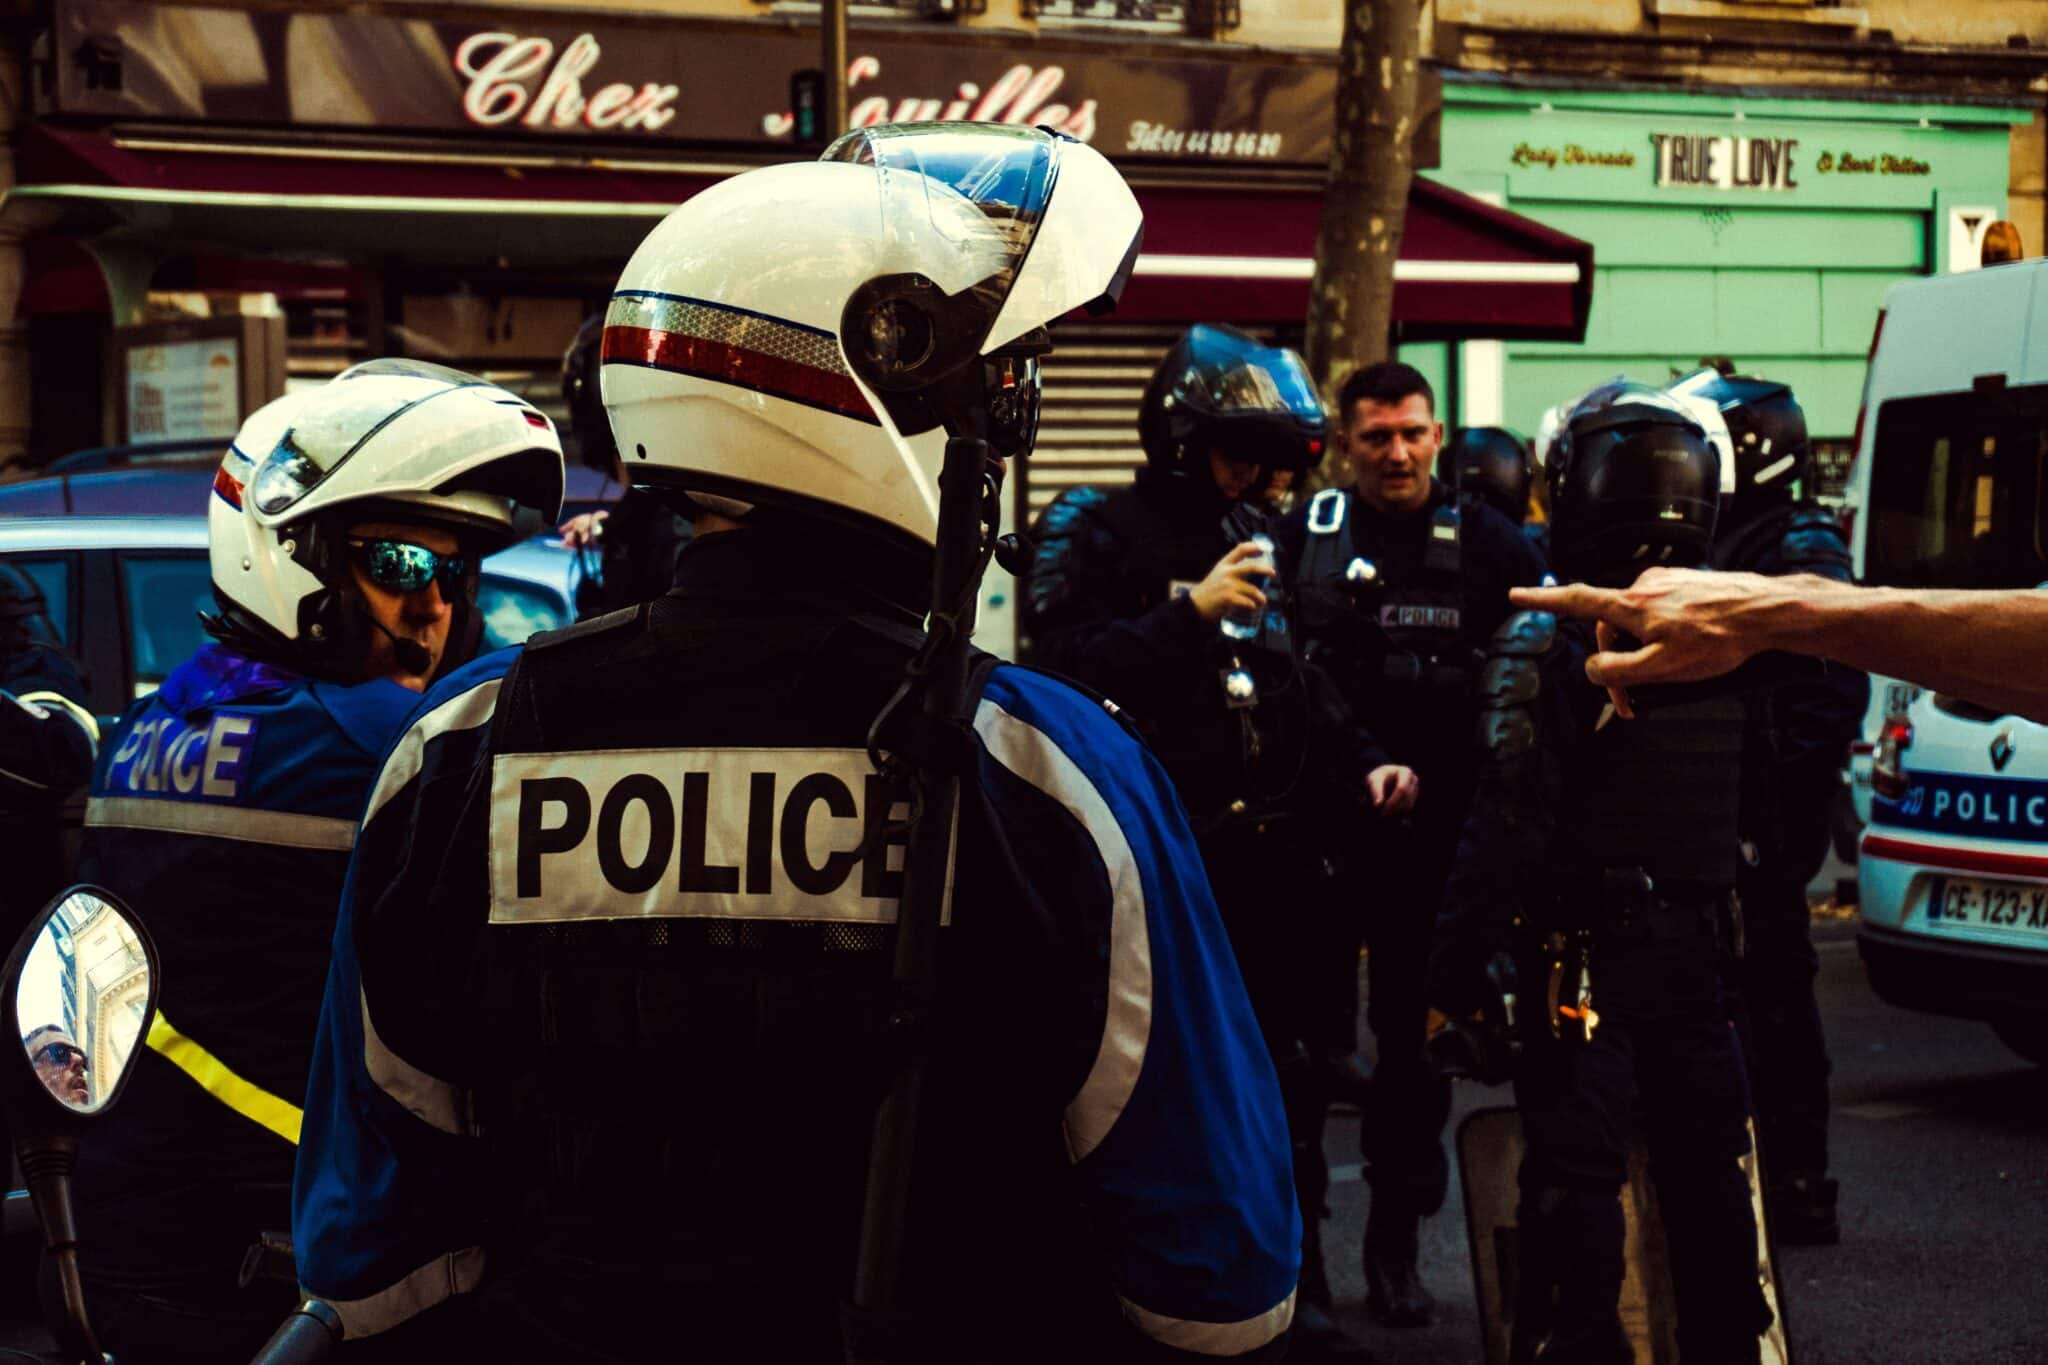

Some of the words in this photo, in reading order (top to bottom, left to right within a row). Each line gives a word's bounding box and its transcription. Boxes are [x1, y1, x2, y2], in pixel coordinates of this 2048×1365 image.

[456, 33, 679, 129] Chez
[763, 56, 1097, 142] ouilles
[1649, 133, 1721, 187] TRUE
[1731, 136, 1799, 190] LOVE
[1402, 607, 1458, 626] POLICE
[103, 715, 253, 798] POLICE
[516, 771, 908, 899] POLICE
